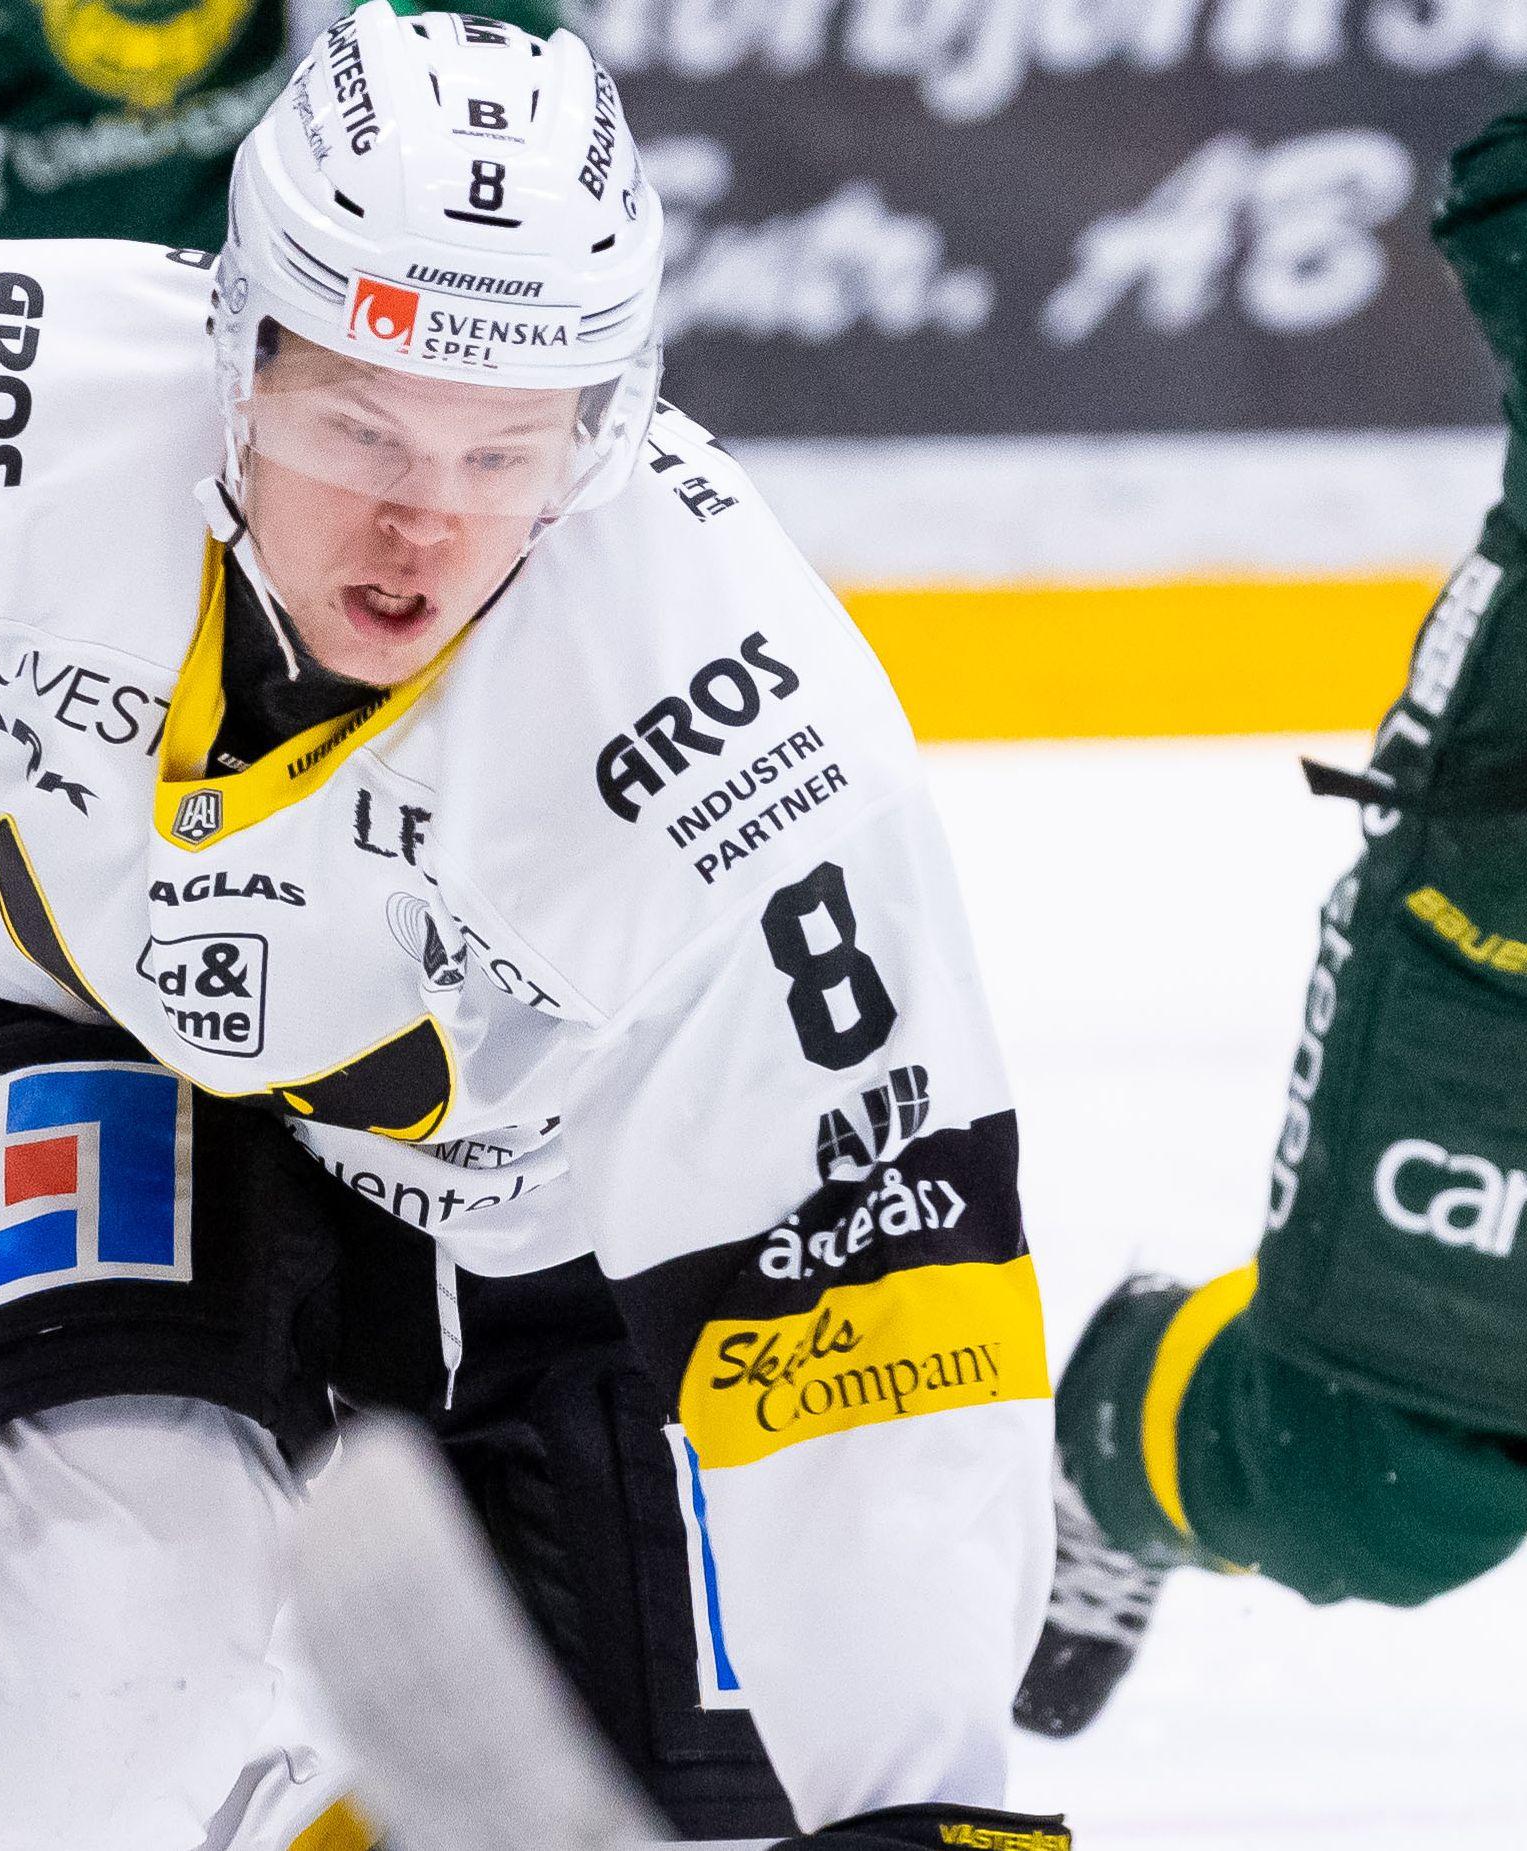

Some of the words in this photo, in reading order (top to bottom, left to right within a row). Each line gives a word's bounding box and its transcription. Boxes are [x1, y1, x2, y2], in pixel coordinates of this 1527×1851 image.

[467, 98, 509, 130] B
[468, 160, 506, 211] 8
[405, 263, 544, 298] WARRIOR
[421, 337, 499, 369] SPEL
[427, 310, 568, 347] SVENSKA
[595, 630, 801, 824] AROS
[666, 724, 825, 850] INDUSTRI
[353, 787, 432, 867] LF
[693, 762, 849, 885] PARTNER
[194, 942, 253, 998] &
[760, 860, 898, 1072] 8
